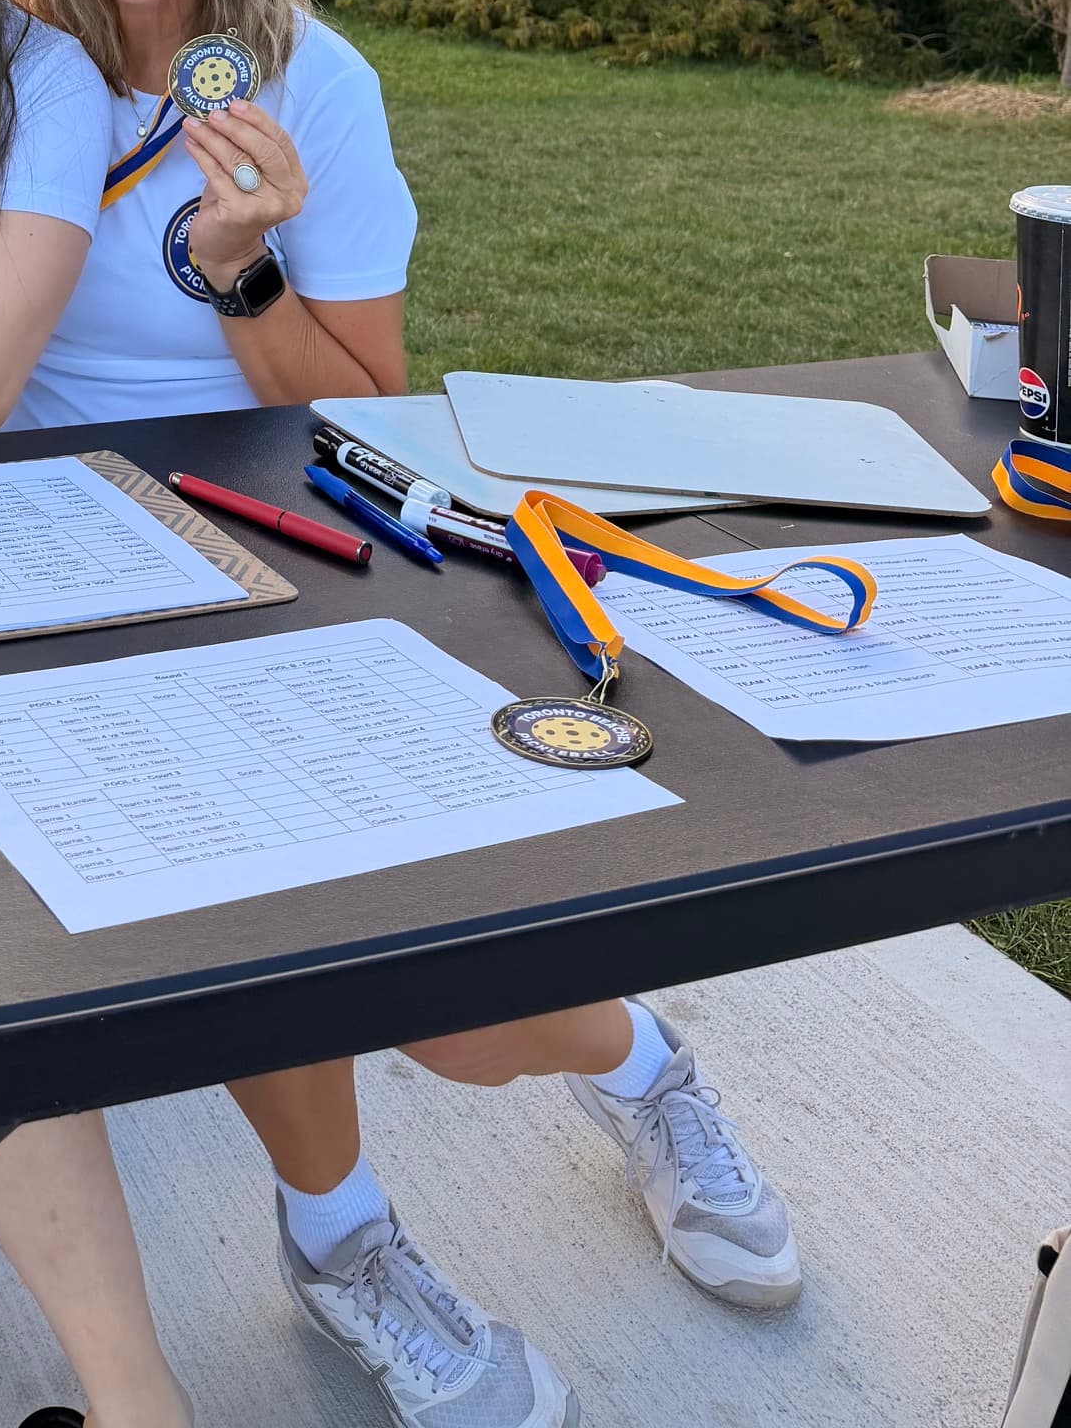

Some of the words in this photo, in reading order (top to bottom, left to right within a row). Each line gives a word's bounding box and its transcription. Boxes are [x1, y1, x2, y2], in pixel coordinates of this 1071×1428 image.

[183, 46, 223, 70] TORONTO
[224, 48, 249, 83] BEACHES
[175, 212, 198, 244] TORO
[518, 708, 587, 723] TORONTO
[515, 732, 616, 759] PICKLEBALL
[329, 751, 361, 759] Number
[103, 779, 132, 787] POOL
[151, 783, 181, 791] Teams
[33, 804, 61, 812] Game
[61, 797, 97, 806] Number
[35, 816, 64, 824] Game
[45, 827, 73, 835] Game
[55, 838, 84, 846] Game
[65, 849, 94, 858] Game
[75, 861, 105, 870] Game
[86, 872, 116, 881] Game
